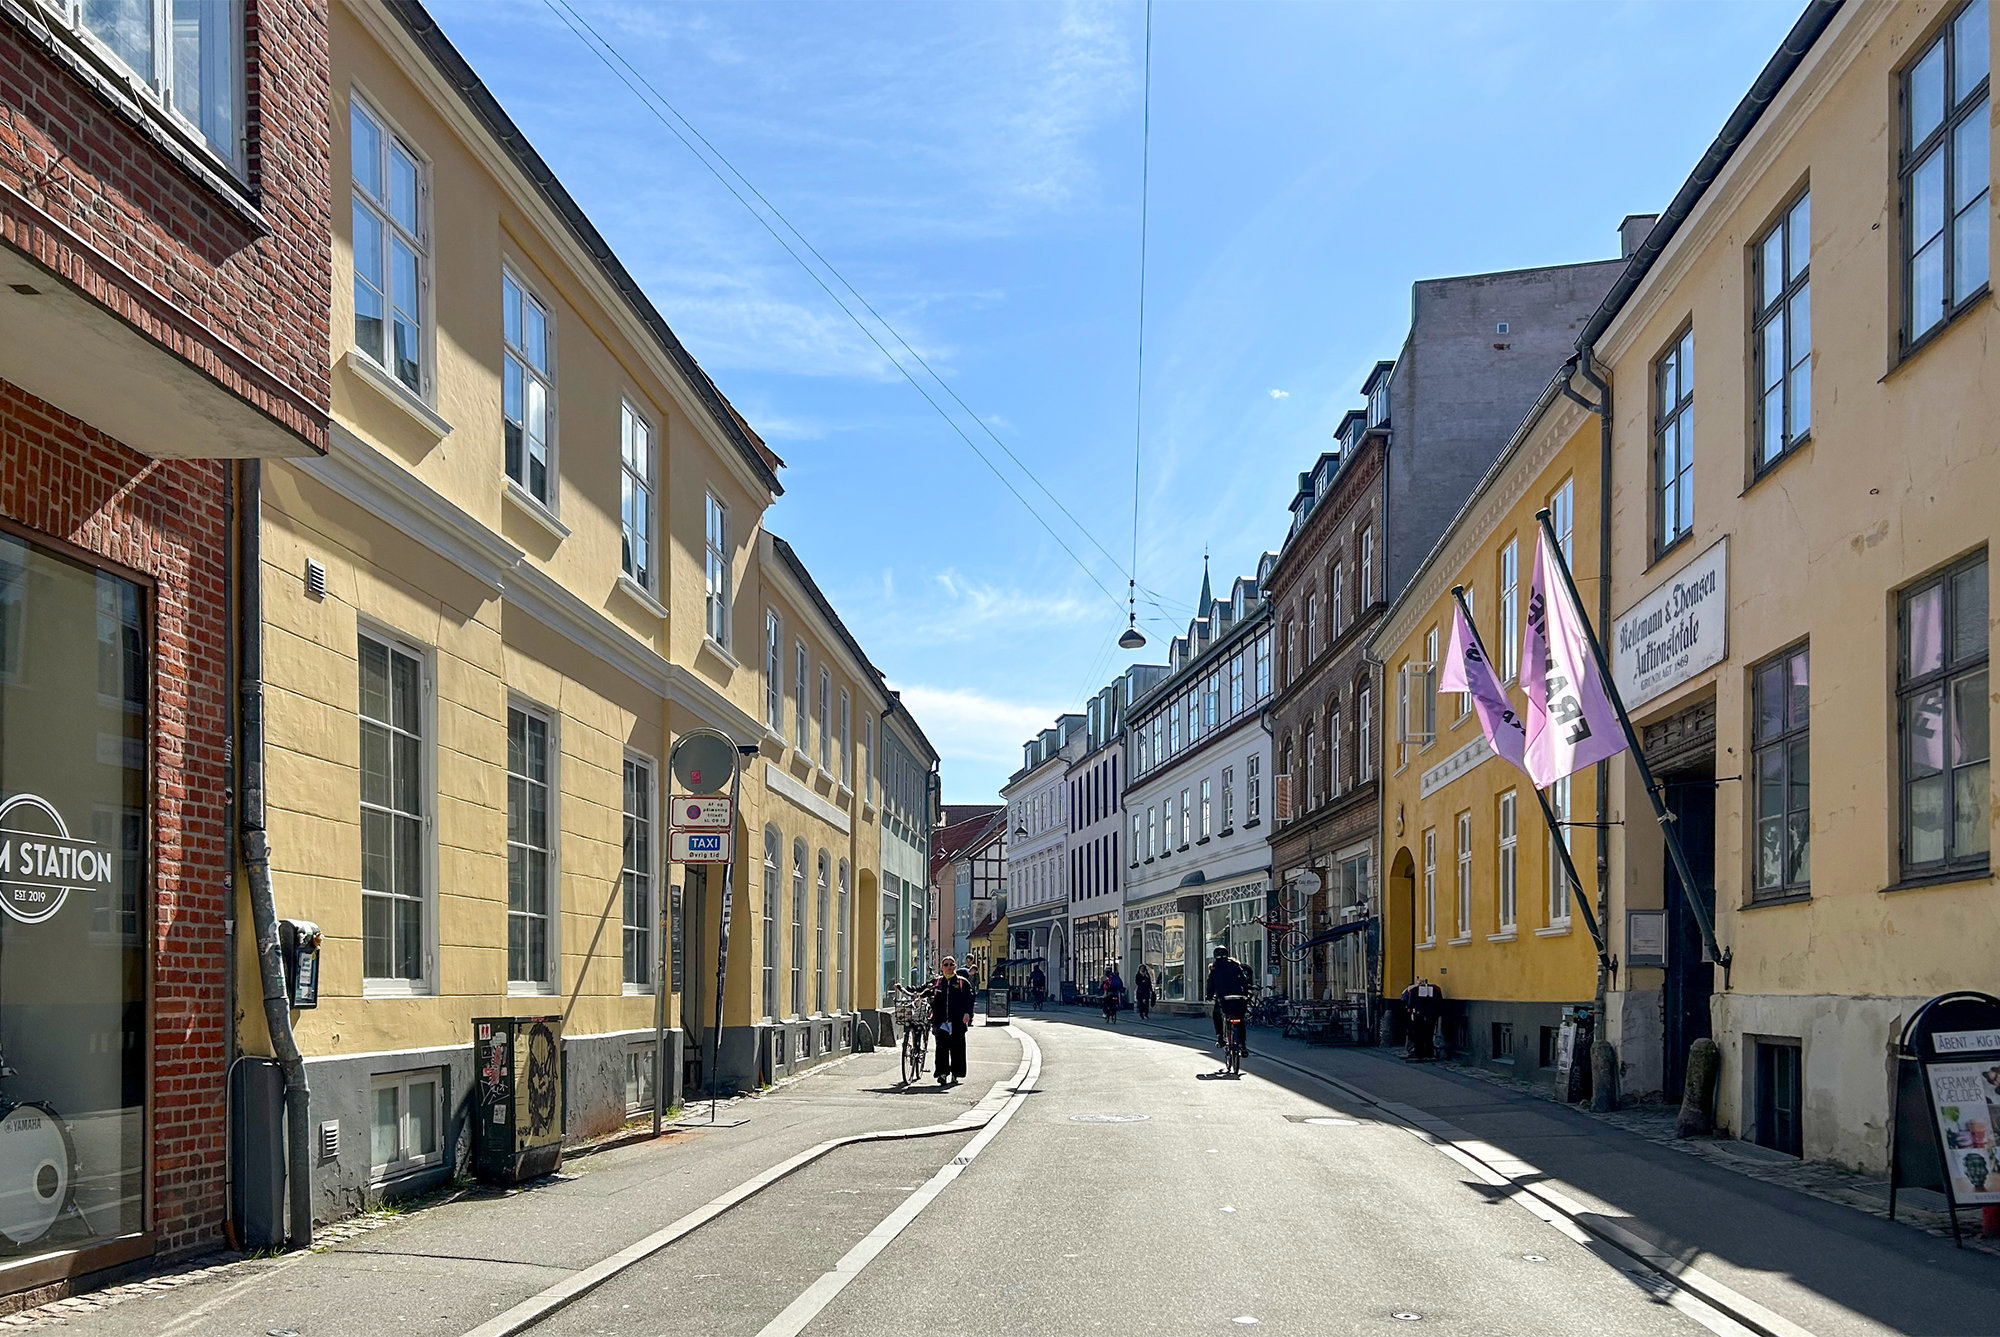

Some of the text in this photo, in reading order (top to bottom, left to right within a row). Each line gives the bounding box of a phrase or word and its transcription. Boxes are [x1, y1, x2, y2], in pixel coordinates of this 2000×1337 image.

[1620, 608, 1662, 654] Nellemann
[1665, 600, 1671, 624] &
[1641, 654, 1689, 691] GRUNDLAGT 1869
[691, 838, 718, 848] TAXI
[20, 842, 111, 883] STATION
[28, 891, 46, 902] 2019
[1939, 1035, 1967, 1050] ÅBENT
[1976, 1035, 1993, 1048] KIG
[1935, 1076, 1980, 1090] KERAMIK
[1937, 1089, 1983, 1103] KÆLDER
[13, 1118, 41, 1132] YAMAHA
